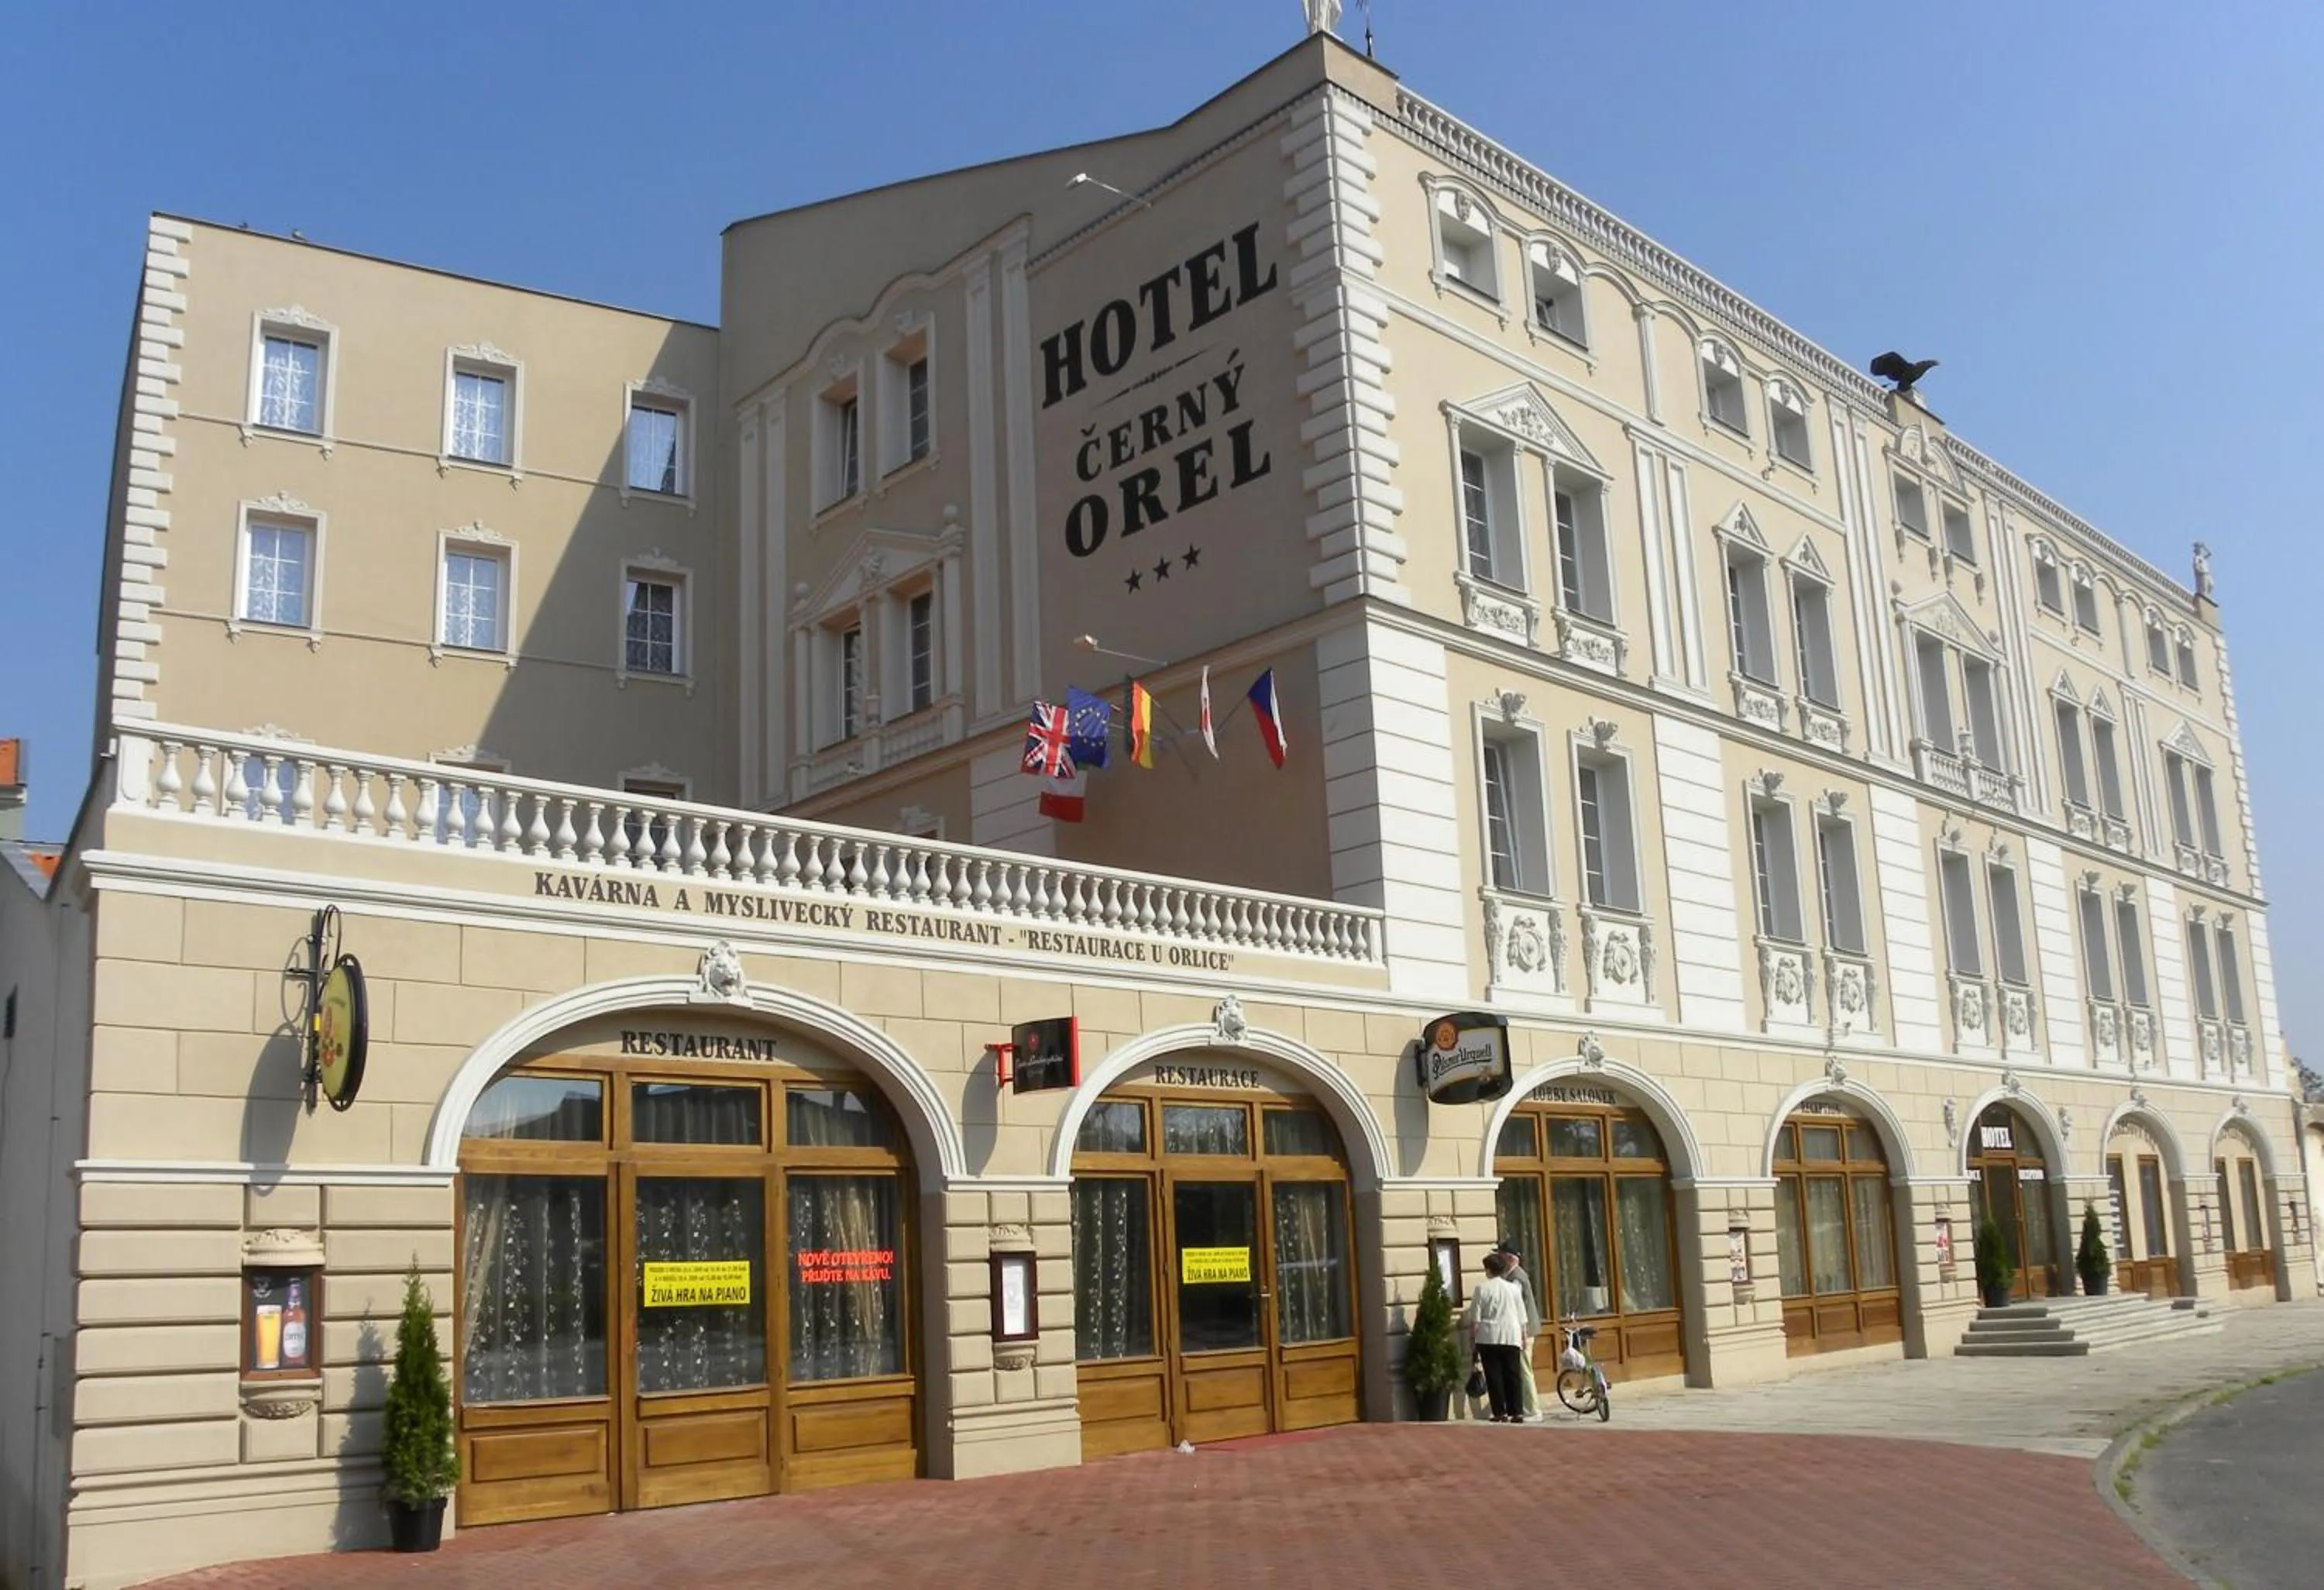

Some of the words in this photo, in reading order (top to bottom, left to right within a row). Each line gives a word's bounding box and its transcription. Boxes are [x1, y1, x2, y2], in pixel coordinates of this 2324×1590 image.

[1040, 221, 1277, 409] HOTEL
[1076, 347, 1246, 482] ČERNÝ
[1065, 419, 1272, 558] OREL
[535, 872, 660, 908] KAVÁRNA
[674, 889, 691, 910] A
[705, 891, 854, 929] MYSLIVECKÝ
[866, 910, 1002, 946] RESTAURANT
[1019, 929, 1146, 962] "RESTAURACE
[1151, 946, 1163, 963] U
[1169, 947, 1235, 971] ORLICE"
[621, 1030, 776, 1062] RESTAURANT
[1155, 1065, 1260, 1089] RESTAURACE
[1981, 1127, 2013, 1148] HOTEL
[845, 1268, 860, 1281] NA
[651, 1285, 673, 1303] ŽIVÁ
[676, 1288, 696, 1303] HRA
[699, 1287, 713, 1302] NA
[716, 1286, 746, 1301] PIANO
